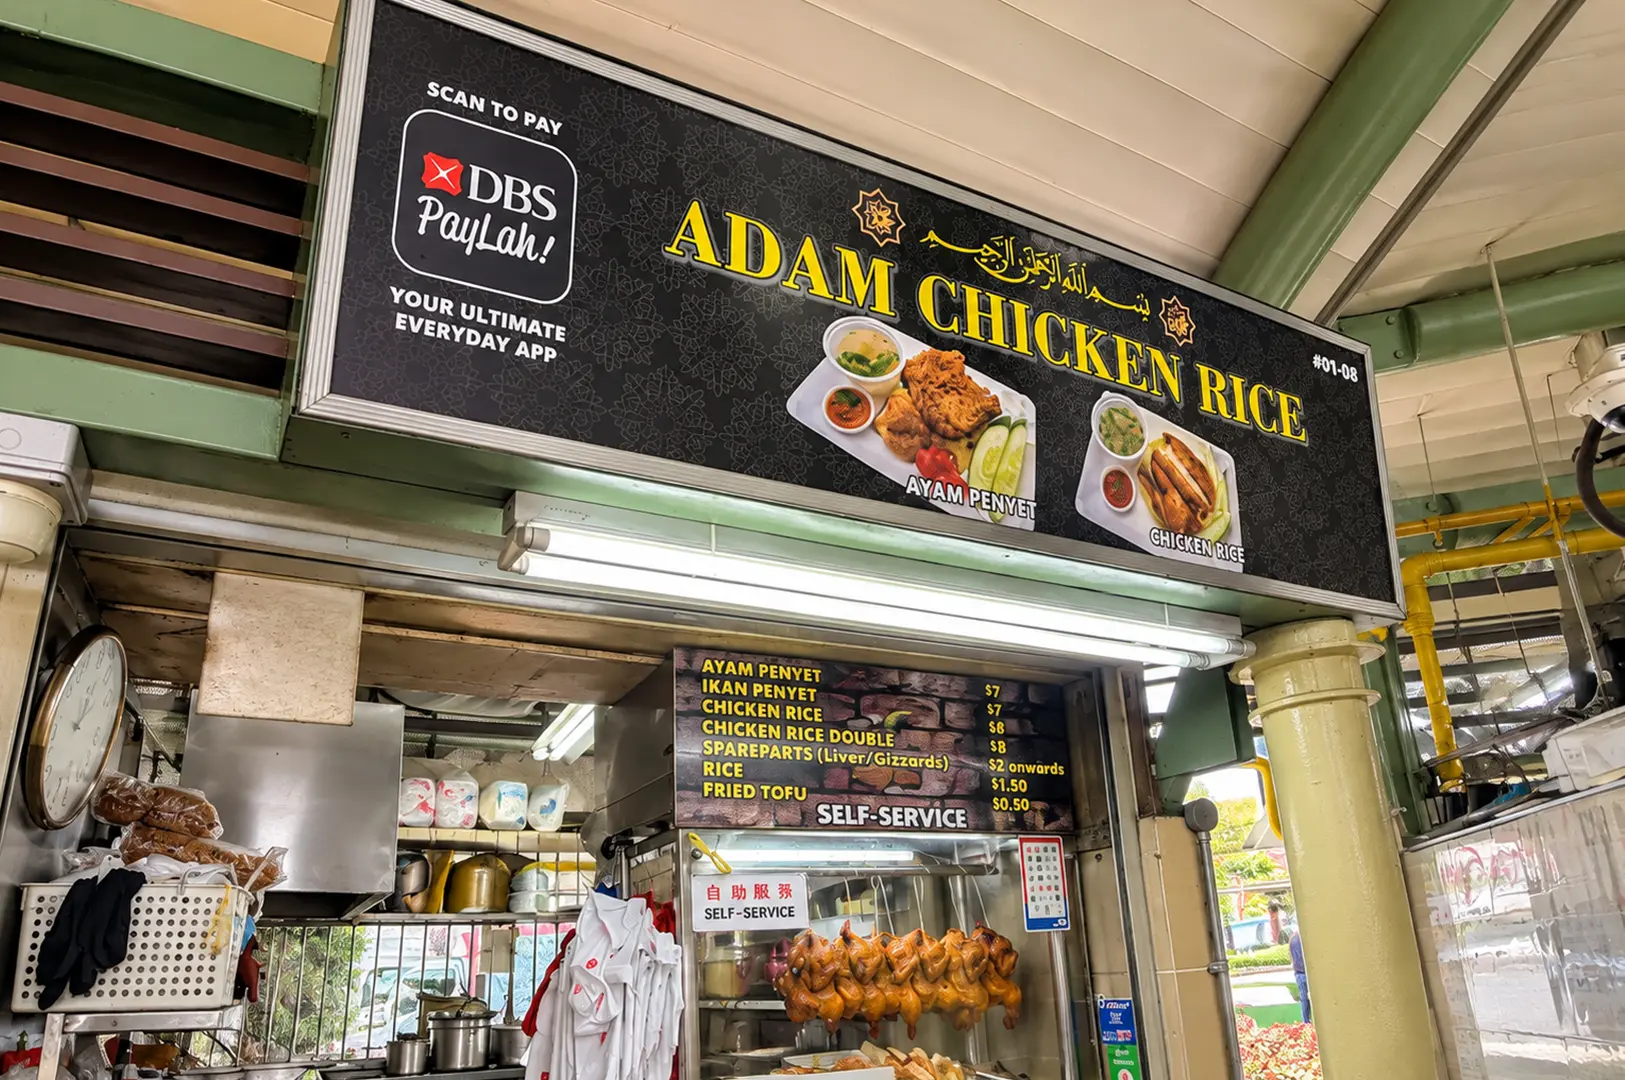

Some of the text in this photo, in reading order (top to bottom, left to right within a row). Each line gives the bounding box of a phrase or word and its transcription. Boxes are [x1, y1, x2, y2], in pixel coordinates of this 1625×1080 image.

[427, 82, 562, 136] SCAN TO PAY
[467, 163, 557, 221] DBS
[417, 195, 556, 264] PayLah!
[390, 286, 566, 343] YOUR ULTIMATE
[663, 199, 1308, 443] ADAM CHICKEN RICE
[395, 312, 557, 363] EVERYDAY APP
[1312, 353, 1359, 384] #01-08
[905, 475, 1038, 520] AYAM PENYET
[1150, 528, 1246, 564] CHICKEN RICE
[702, 659, 821, 683] AYAM PENYET
[702, 678, 817, 702] IKAN PENYET
[984, 683, 1001, 699] $7
[702, 699, 823, 722] CHICKEN RICE
[986, 703, 1003, 717] $7
[702, 719, 894, 747] CHICKEN RICE DOUBLE
[702, 739, 950, 772] SPAREPARTS (Liver/Gizzards)
[989, 740, 1007, 754] $8
[703, 761, 743, 778] RICE
[988, 758, 1065, 775] $2 onwards
[703, 781, 807, 801] FRIED TOFU
[991, 777, 1028, 793] $1.50
[816, 803, 968, 829] SELF-SERVICE
[992, 797, 1030, 812] $0.50
[704, 906, 795, 920] SELF-SERVICE
